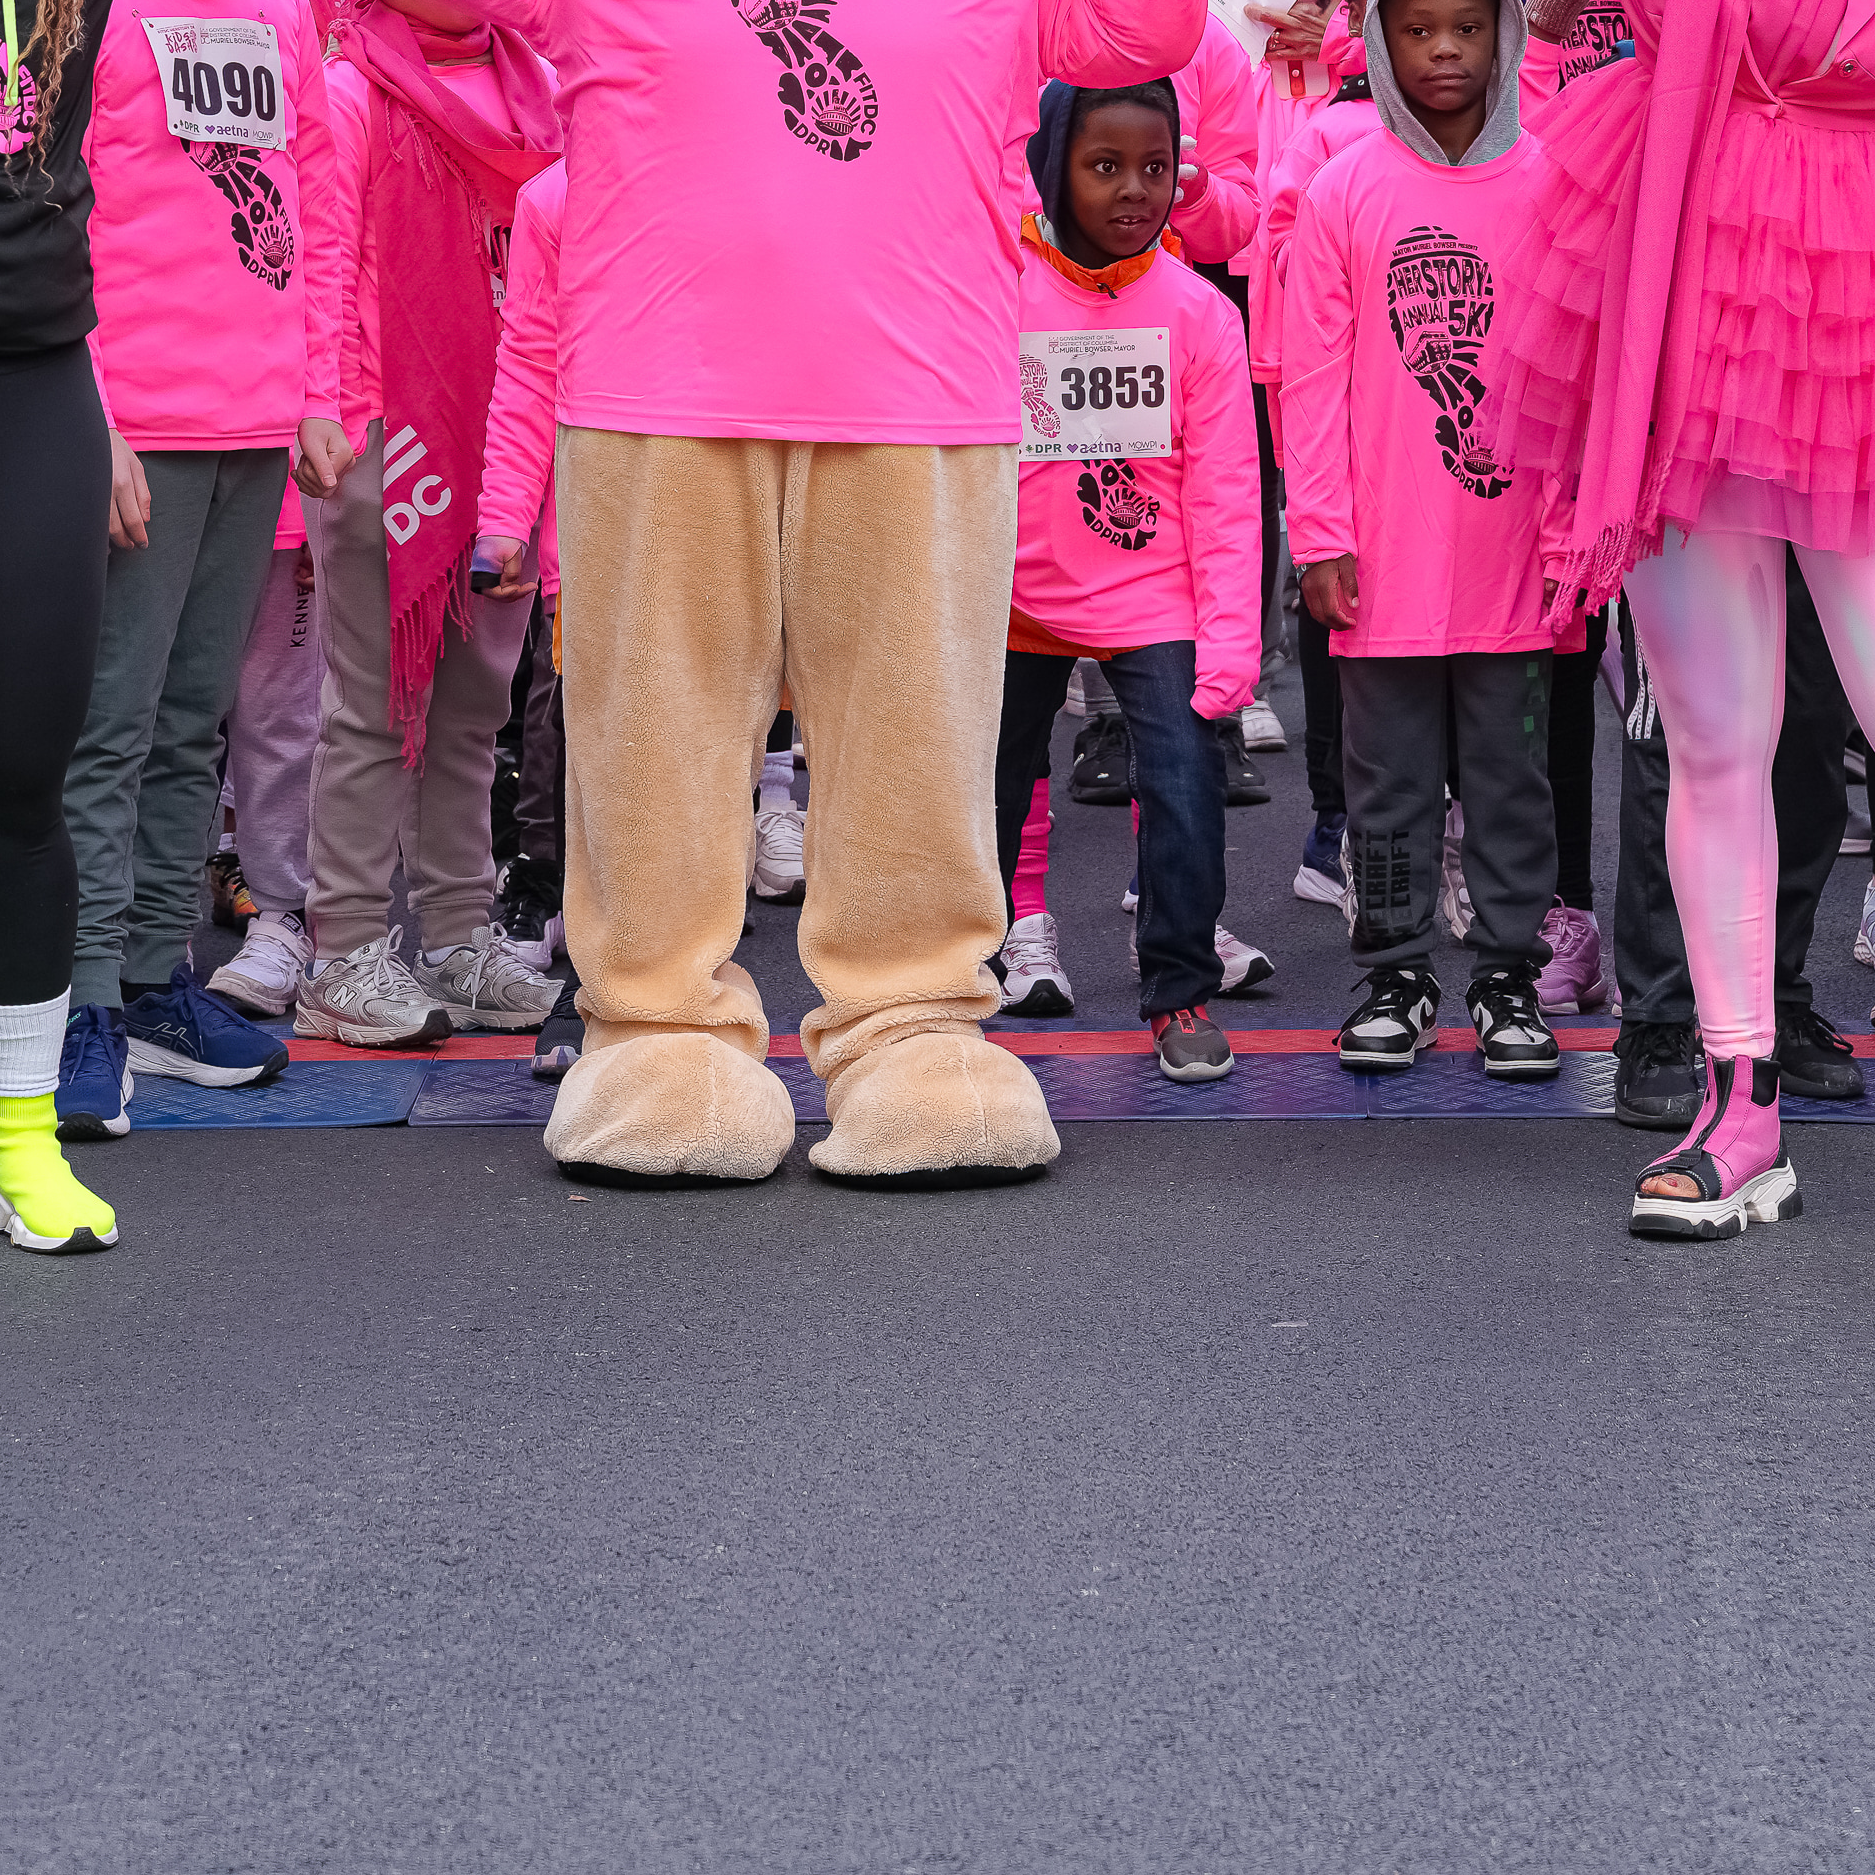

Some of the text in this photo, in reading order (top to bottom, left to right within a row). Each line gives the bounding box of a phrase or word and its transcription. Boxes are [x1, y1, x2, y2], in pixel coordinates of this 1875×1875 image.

[18, 64, 36, 126] FITDC
[171, 57, 276, 122] 4090
[853, 71, 879, 135] FITDC
[184, 121, 200, 133] DPR
[216, 124, 249, 138] aetna
[792, 123, 830, 156] DPR
[1392, 245, 1411, 256] MAYOR
[1412, 242, 1432, 251] MURIEL
[246, 259, 274, 286] DPR
[1393, 257, 1488, 301] HERSTORY
[1402, 299, 1487, 338] ANNUAL 5K
[1059, 346, 1083, 354] MURIEL
[1060, 364, 1164, 411] 3853
[1035, 443, 1062, 453] DPR
[1079, 440, 1122, 453] aetna
[1451, 465, 1475, 492] DPR
[383, 474, 452, 546] DC
[1090, 518, 1122, 546] DPR
